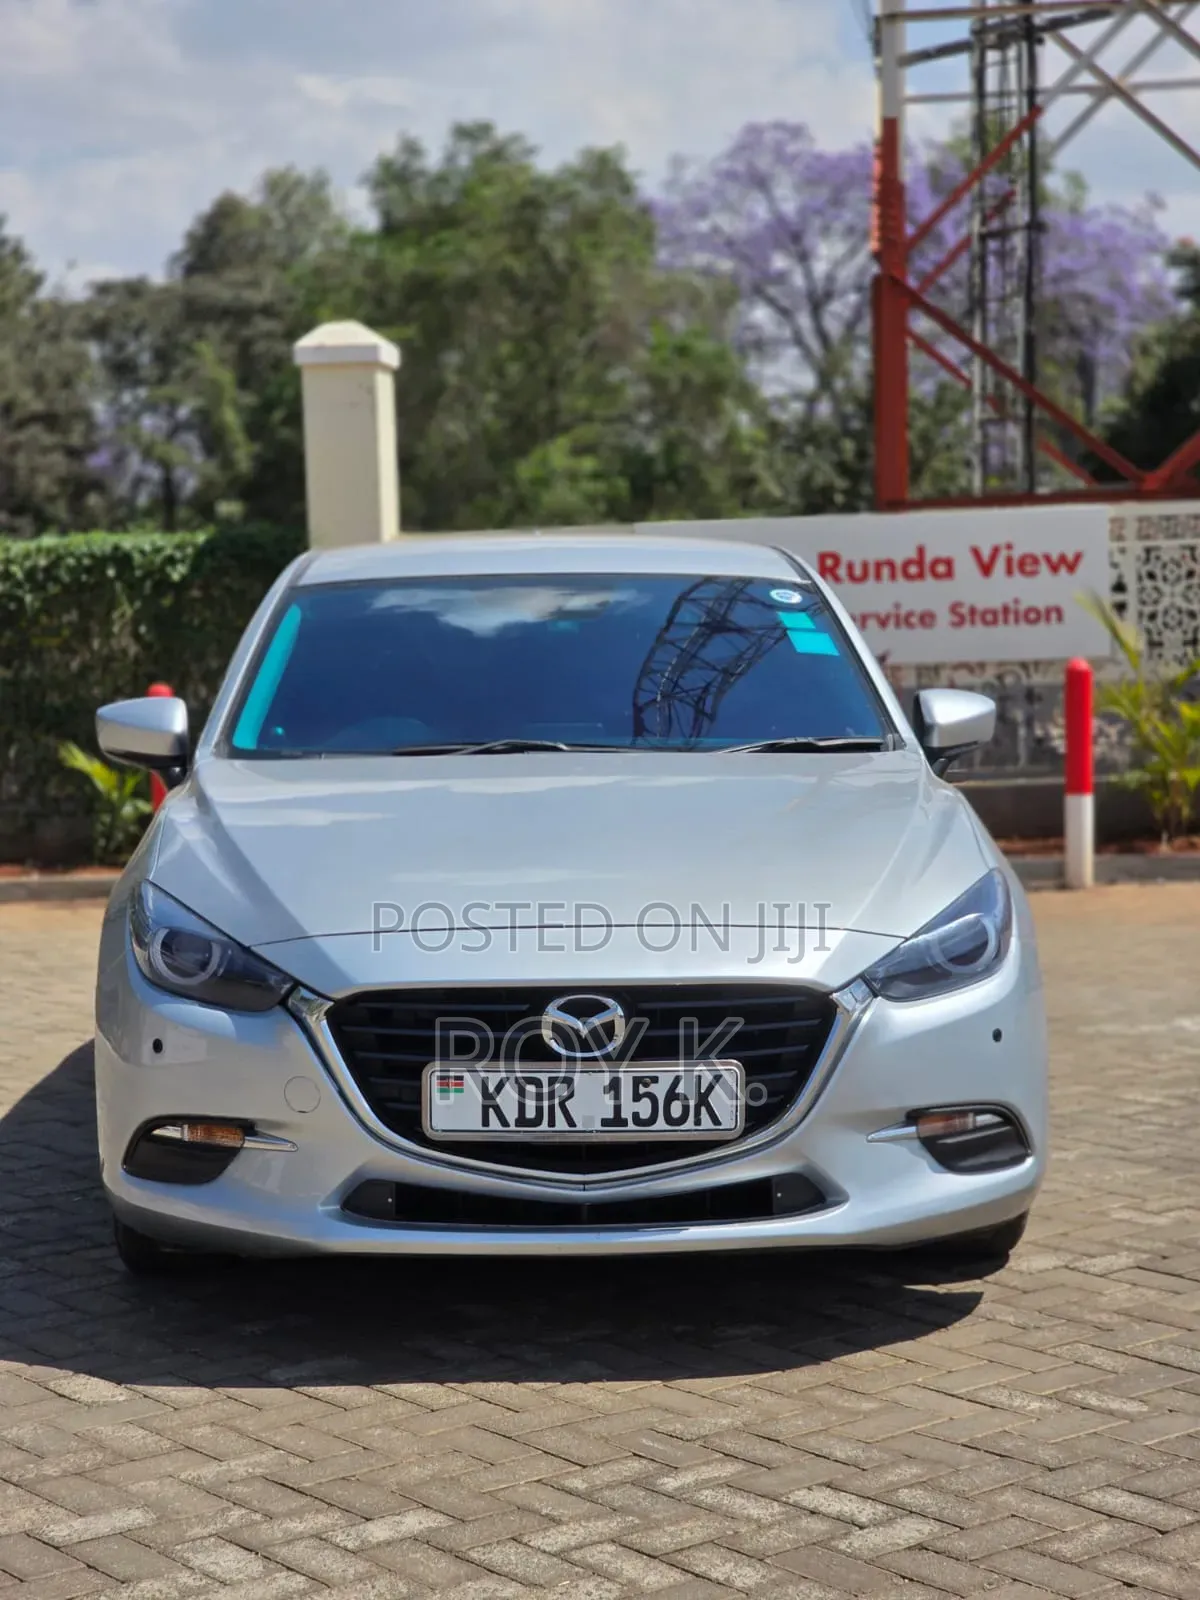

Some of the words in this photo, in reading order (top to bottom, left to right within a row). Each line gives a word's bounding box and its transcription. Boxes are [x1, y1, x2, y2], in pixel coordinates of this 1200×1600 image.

[816, 545, 954, 584] Runda
[970, 543, 1084, 580] View
[849, 600, 937, 631] rvice
[948, 598, 1064, 629] Station
[480, 1075, 578, 1128] KDR
[600, 1074, 723, 1128] 156K
